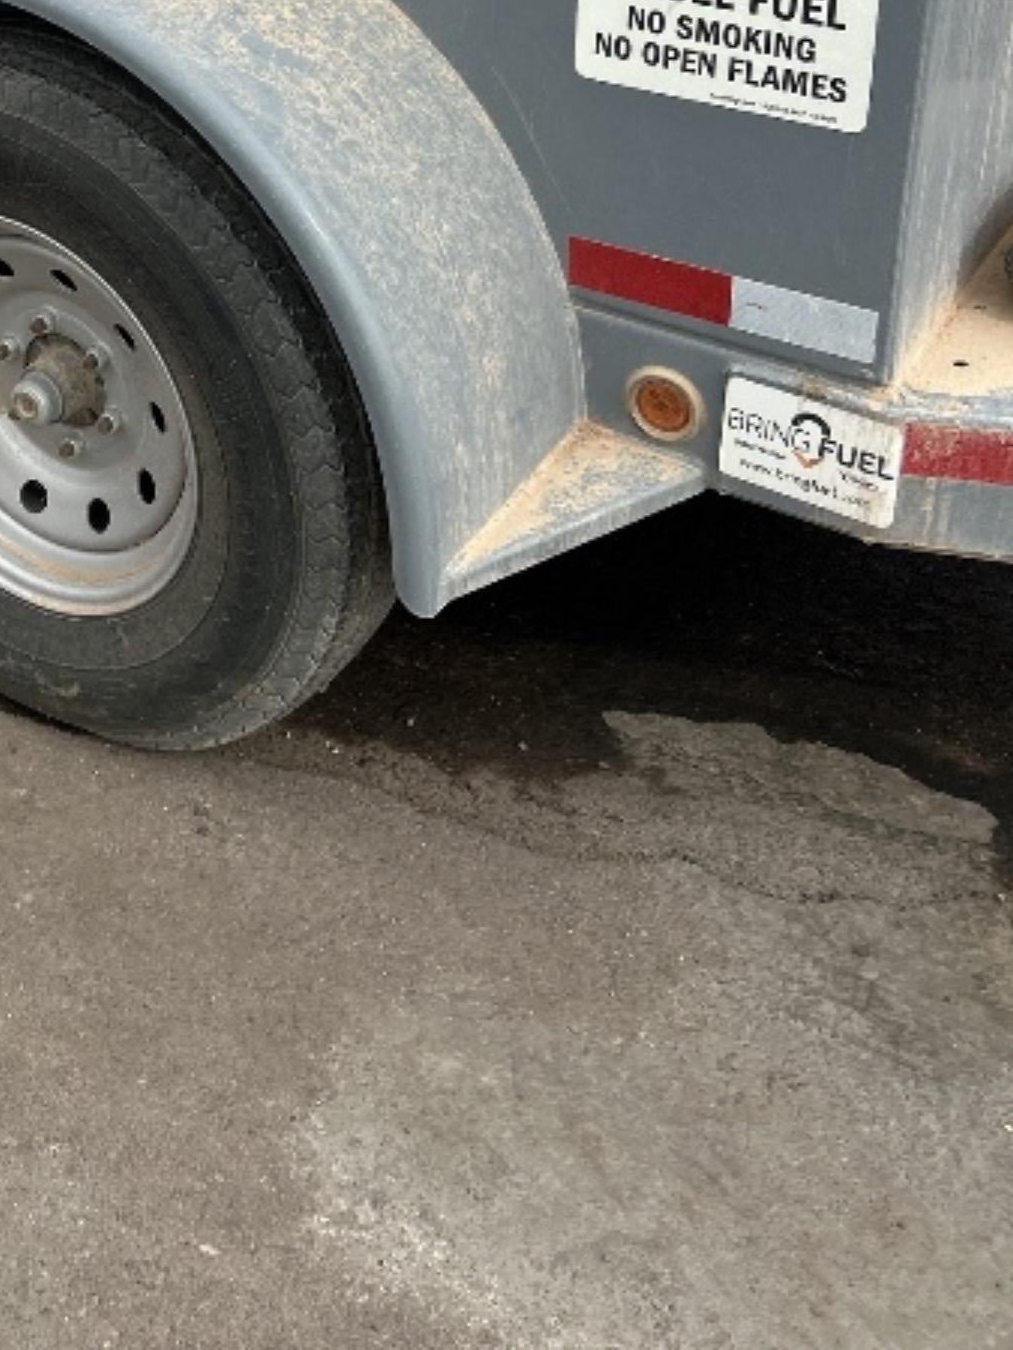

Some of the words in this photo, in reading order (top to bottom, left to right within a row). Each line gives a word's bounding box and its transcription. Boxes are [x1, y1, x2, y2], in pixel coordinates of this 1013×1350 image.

[628, 5, 666, 34] NO
[676, 14, 817, 64] SMOKING
[595, 32, 631, 61] NO
[642, 41, 718, 79] OPEN
[727, 57, 847, 104] FLAMES
